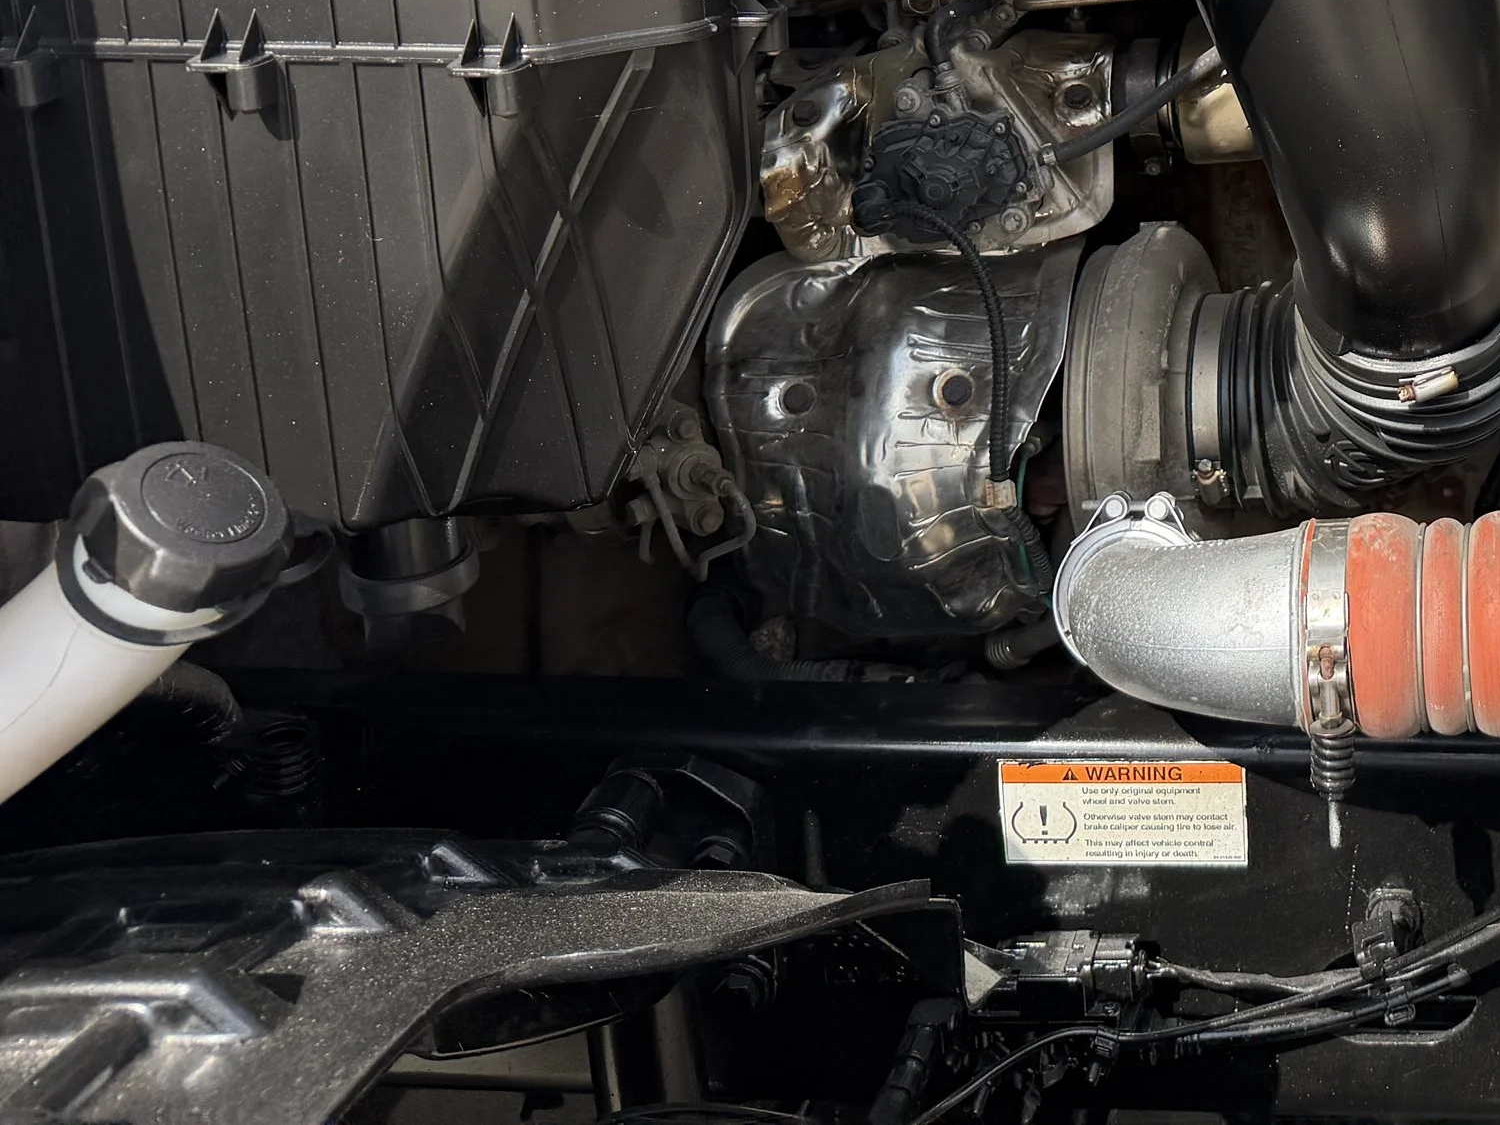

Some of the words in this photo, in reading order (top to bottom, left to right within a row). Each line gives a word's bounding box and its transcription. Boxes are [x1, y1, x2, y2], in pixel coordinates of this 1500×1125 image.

[1085, 766, 1183, 781] WARNING
[1082, 787, 1099, 795] Use
[1100, 786, 1119, 796] only
[1121, 787, 1153, 796] original
[1155, 787, 1201, 796] equipment
[1082, 797, 1107, 805] wheel
[1109, 797, 1126, 805] and
[1127, 797, 1151, 805] valve
[1083, 813, 1127, 821] Otherwise
[1153, 813, 1175, 821] stem
[1176, 814, 1194, 822] may
[1083, 822, 1109, 830] brake
[1110, 823, 1139, 832] caliper
[1140, 823, 1175, 832] causing
[1176, 823, 1191, 831] tire
[1193, 823, 1202, 831] to
[1203, 823, 1222, 831] lose
[1223, 823, 1238, 831] air.
[1085, 839, 1103, 847] This
[1105, 840, 1124, 849] may
[1125, 839, 1150, 847] affect
[1151, 839, 1182, 847] vehicle
[1085, 850, 1123, 859] resulting
[1135, 850, 1160, 859] injury
